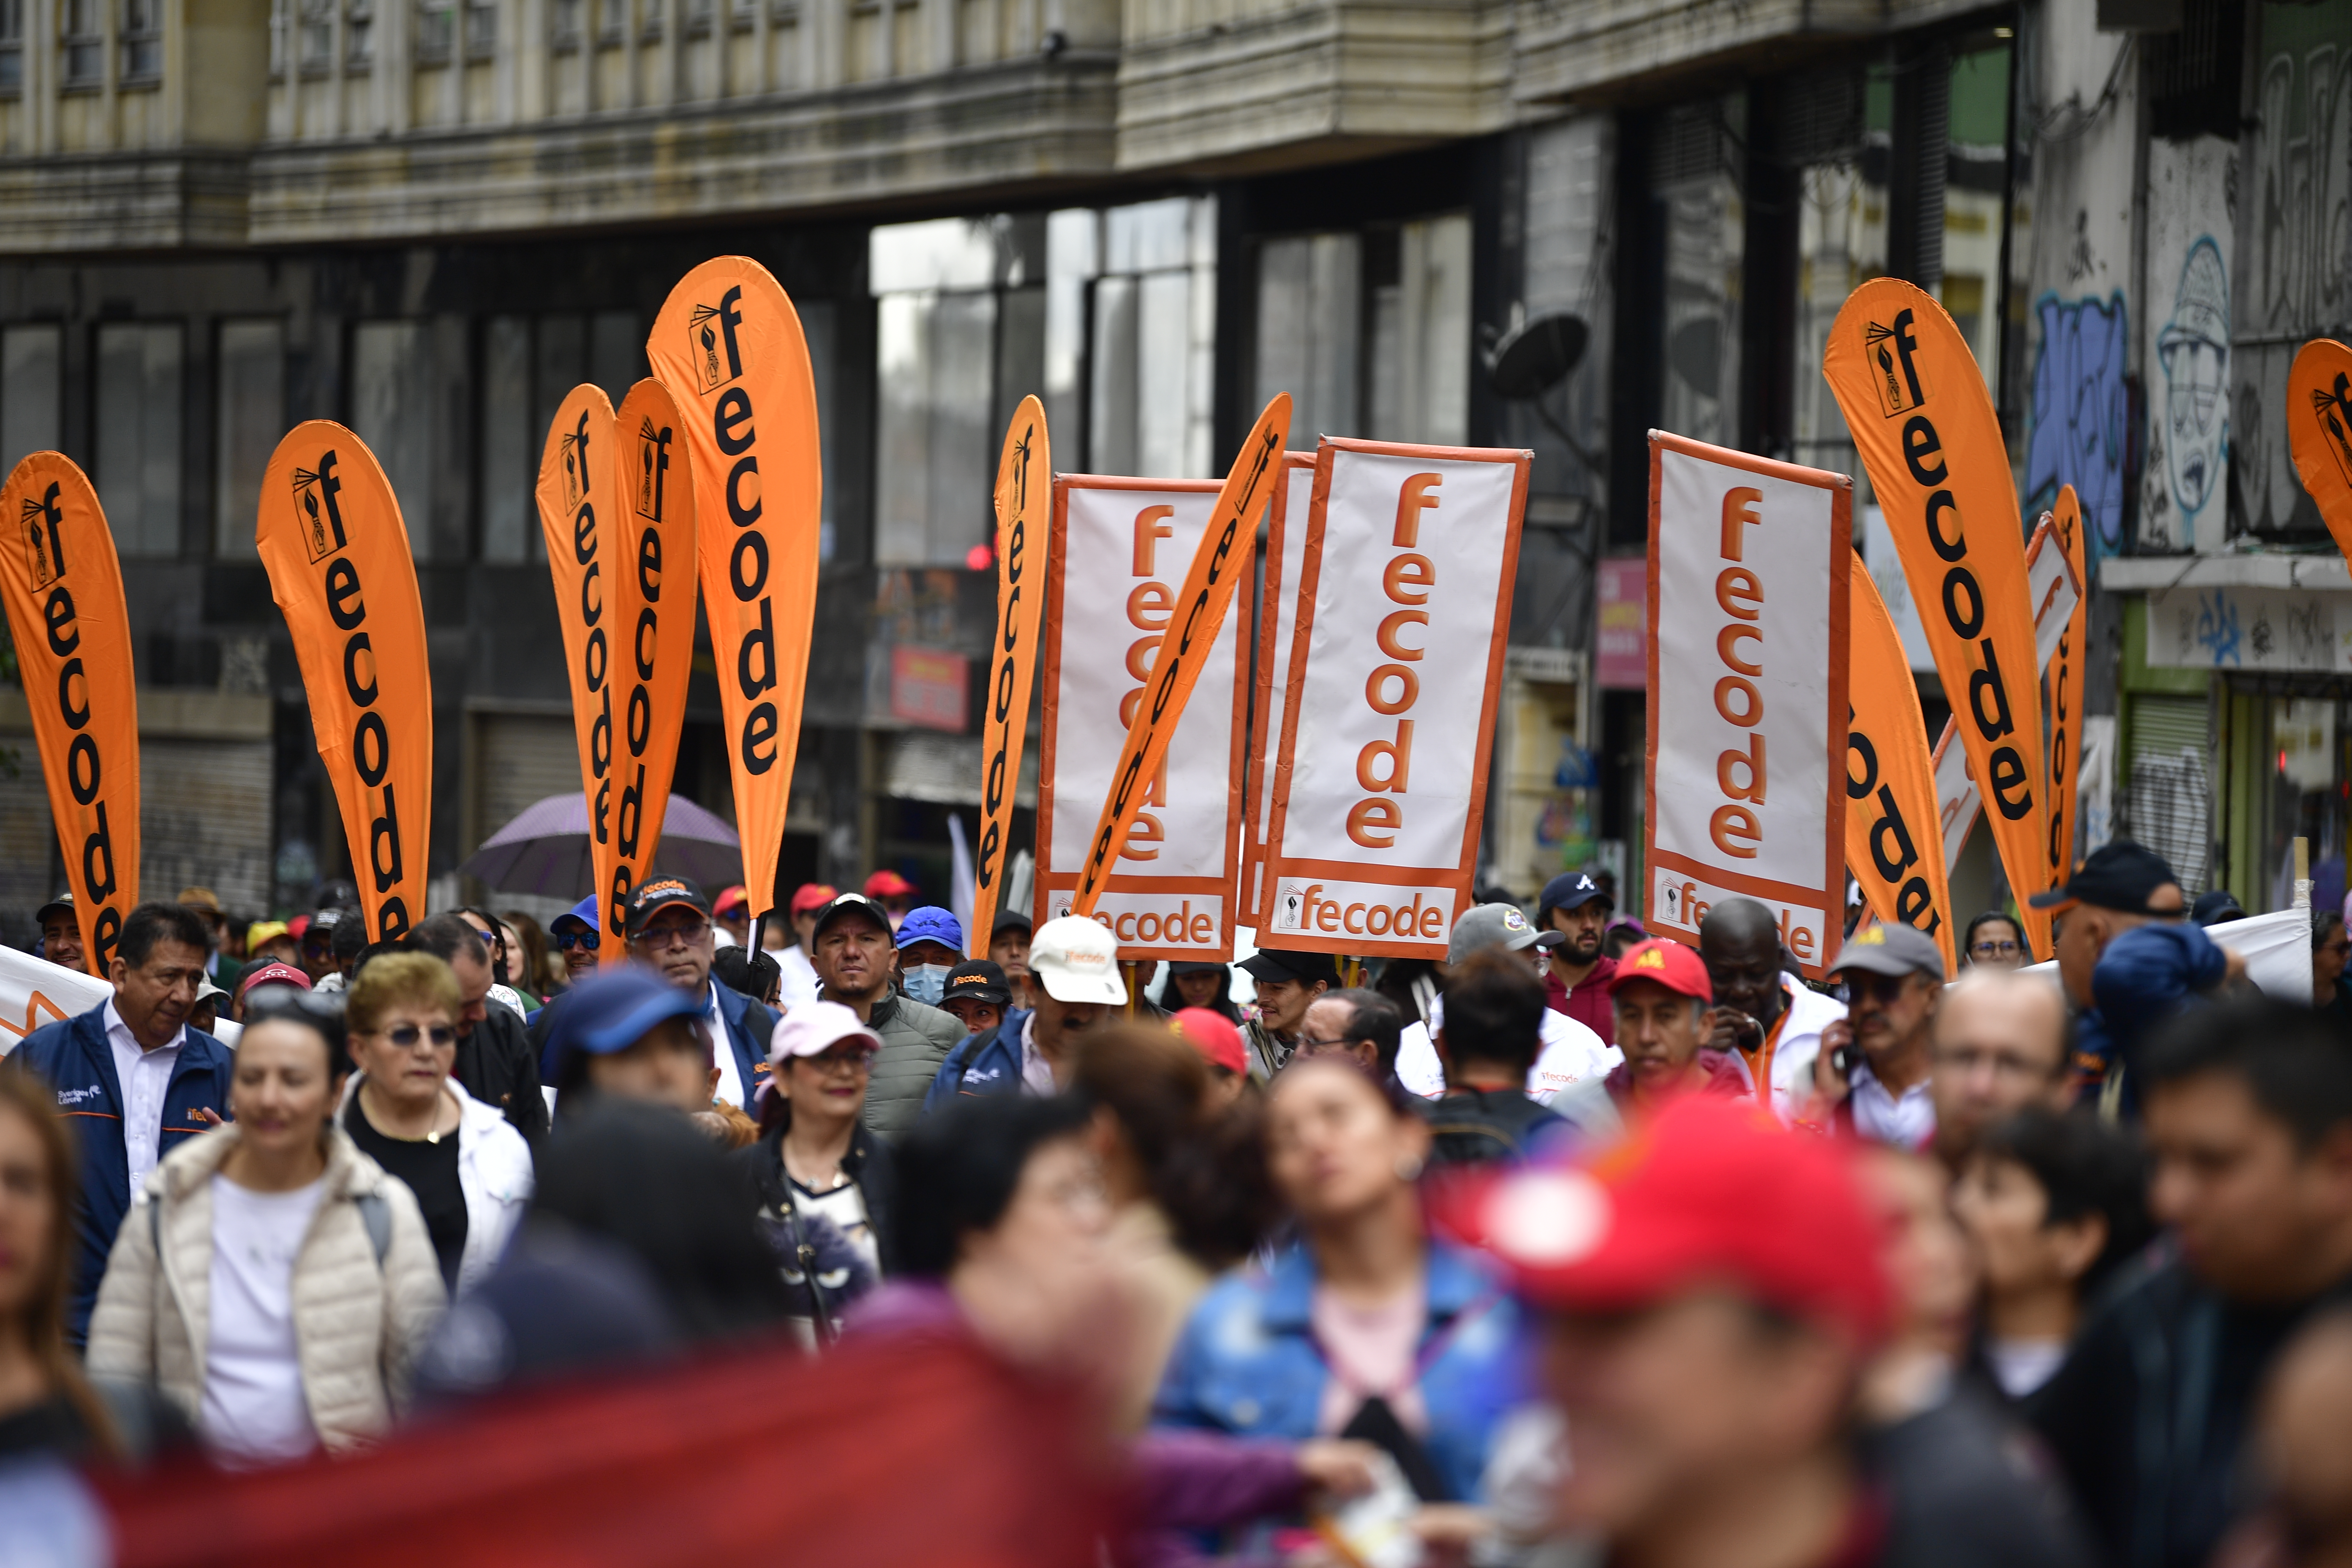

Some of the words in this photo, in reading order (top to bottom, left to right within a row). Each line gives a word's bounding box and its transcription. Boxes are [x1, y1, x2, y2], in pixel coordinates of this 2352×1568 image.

[44, 481, 121, 980] fecode
[318, 449, 409, 941] fecode
[574, 408, 612, 844] fecode
[610, 426, 672, 938] fecode
[714, 285, 779, 776] fecode
[978, 423, 1033, 890] fecode
[1086, 433, 1279, 895] fecode
[1346, 472, 1443, 849] fecode
[1709, 486, 1767, 859] fecode
[1894, 308, 2034, 820] fecode
[1301, 885, 1443, 939] fecode
